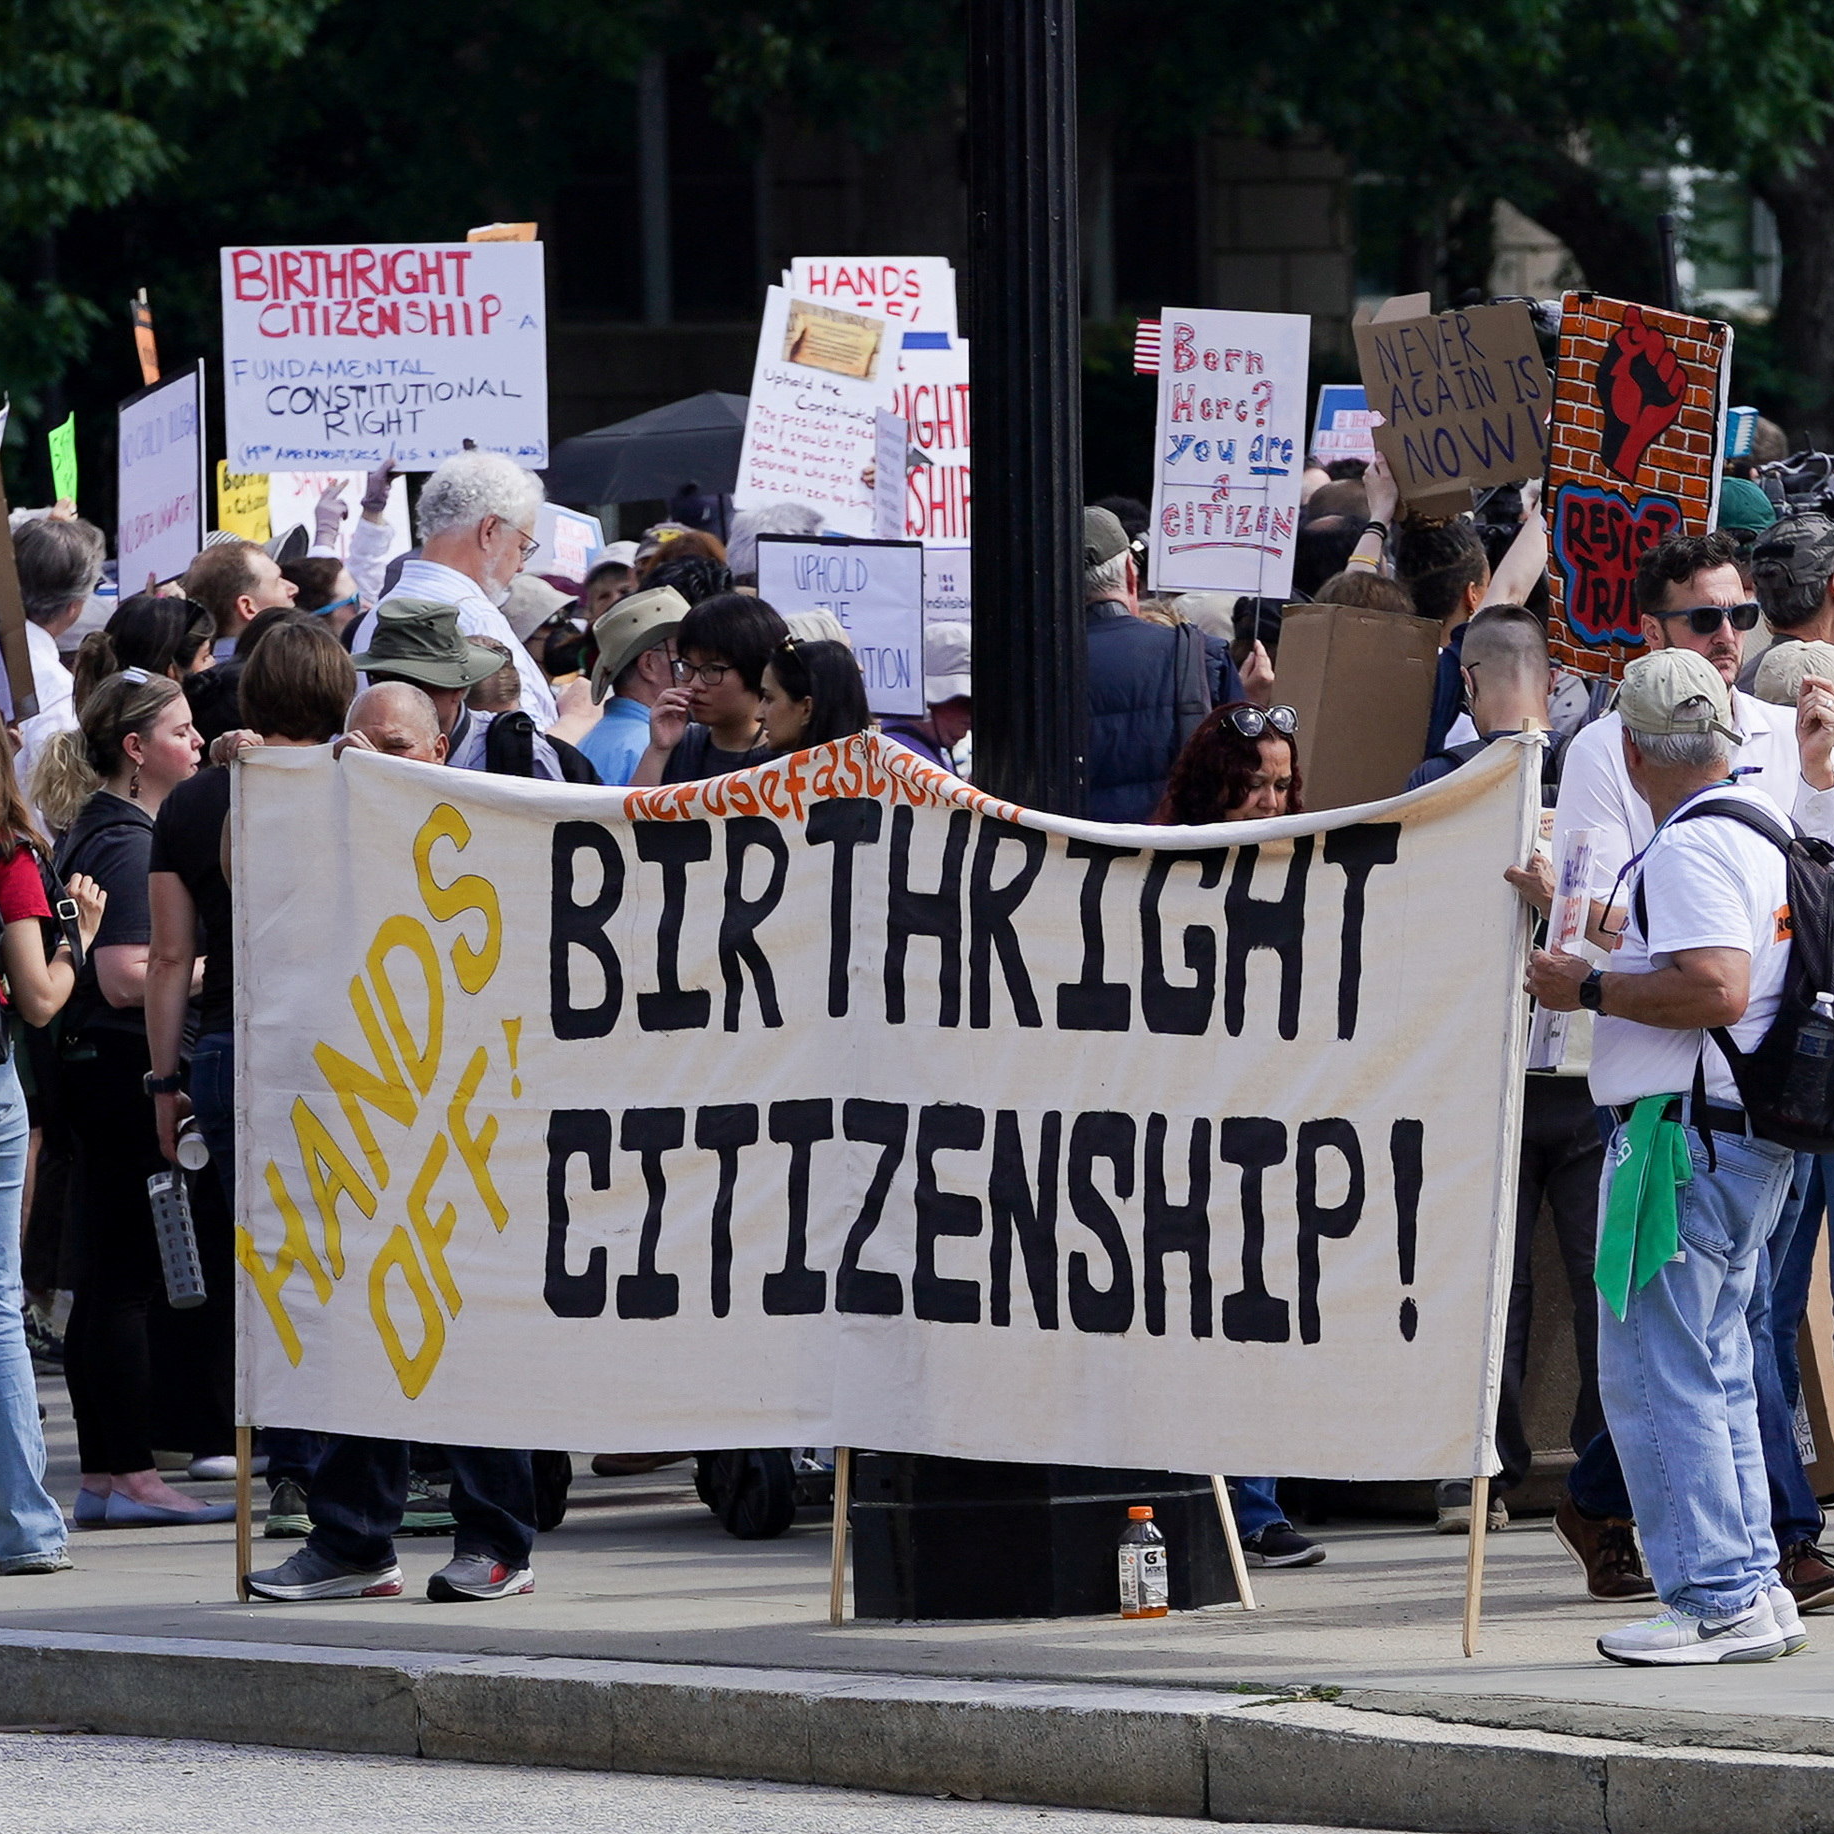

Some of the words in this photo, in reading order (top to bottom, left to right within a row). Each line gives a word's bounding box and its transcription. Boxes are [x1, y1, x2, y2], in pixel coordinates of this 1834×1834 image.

[231, 248, 472, 301] BIRTHRIGHT
[809, 265, 920, 298] HANDS
[258, 294, 502, 339] CITIZENSHIP
[1173, 322, 1264, 374] Born
[1375, 314, 1486, 384] NEVER
[231, 359, 435, 387] FUNDAMENTAL
[266, 377, 523, 415] CONSTITUTIONAL
[1391, 364, 1497, 427] AGAIN
[1504, 355, 1541, 404] IS
[323, 408, 426, 441] RIGHT
[1171, 380, 1273, 427] Here?
[1161, 502, 1295, 541] CITIZEN
[793, 554, 868, 594] UPHOLD
[550, 797, 1401, 1041] BIRTHRIGHT
[235, 805, 501, 1365] HANDS
[544, 1098, 1423, 1345] CITIZENSHIP!
